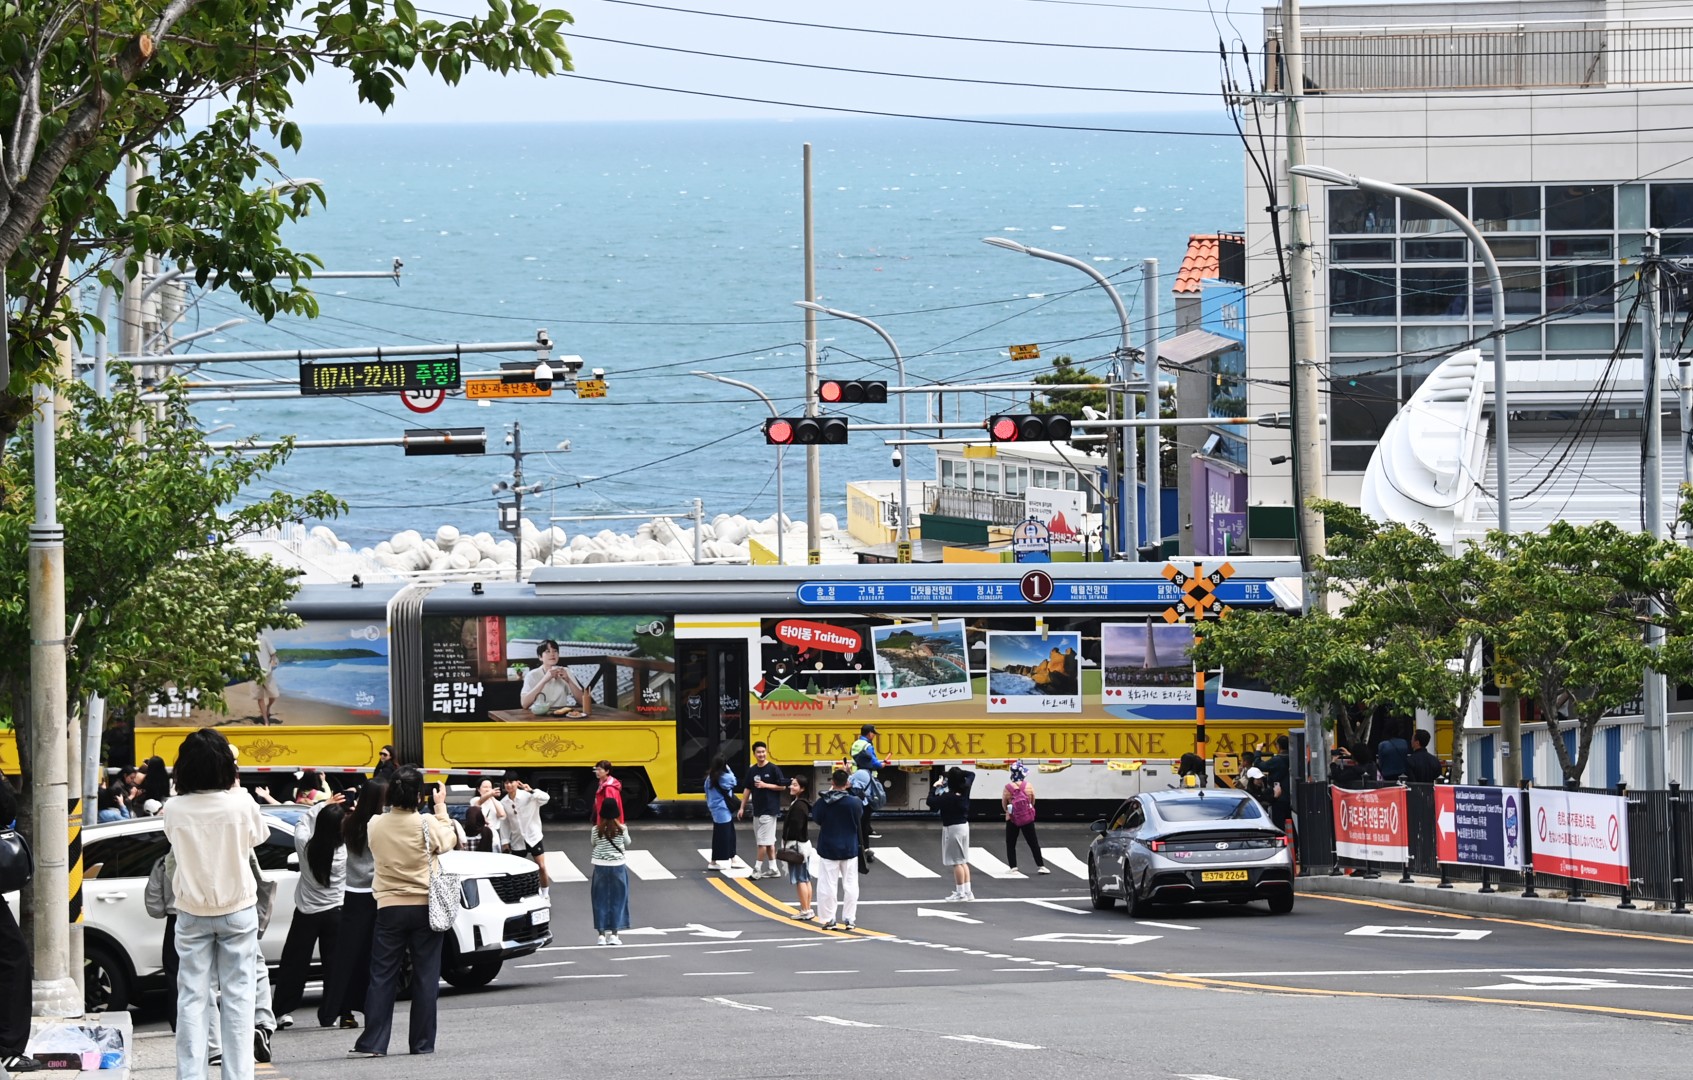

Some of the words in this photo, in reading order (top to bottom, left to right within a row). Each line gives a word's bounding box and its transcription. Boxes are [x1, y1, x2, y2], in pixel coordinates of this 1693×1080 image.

[977, 586, 1003, 595] 청사포
[1158, 585, 1186, 595] 달맞이
[1245, 585, 1259, 594] 미포
[1030, 576, 1042, 598] 1
[780, 625, 813, 641] 타이동
[814, 630, 856, 648] Taitung
[433, 683, 450, 698] 또
[453, 682, 484, 697] 만나
[148, 702, 191, 718] 대만!
[432, 698, 476, 713] 대만!
[758, 700, 823, 710] TAIWAN
[802, 733, 985, 755] HAUNDAE
[1006, 732, 1165, 755] BLUELINE
[1379, 807, 1389, 829] 금지
[1225, 872, 1245, 880] 2264
